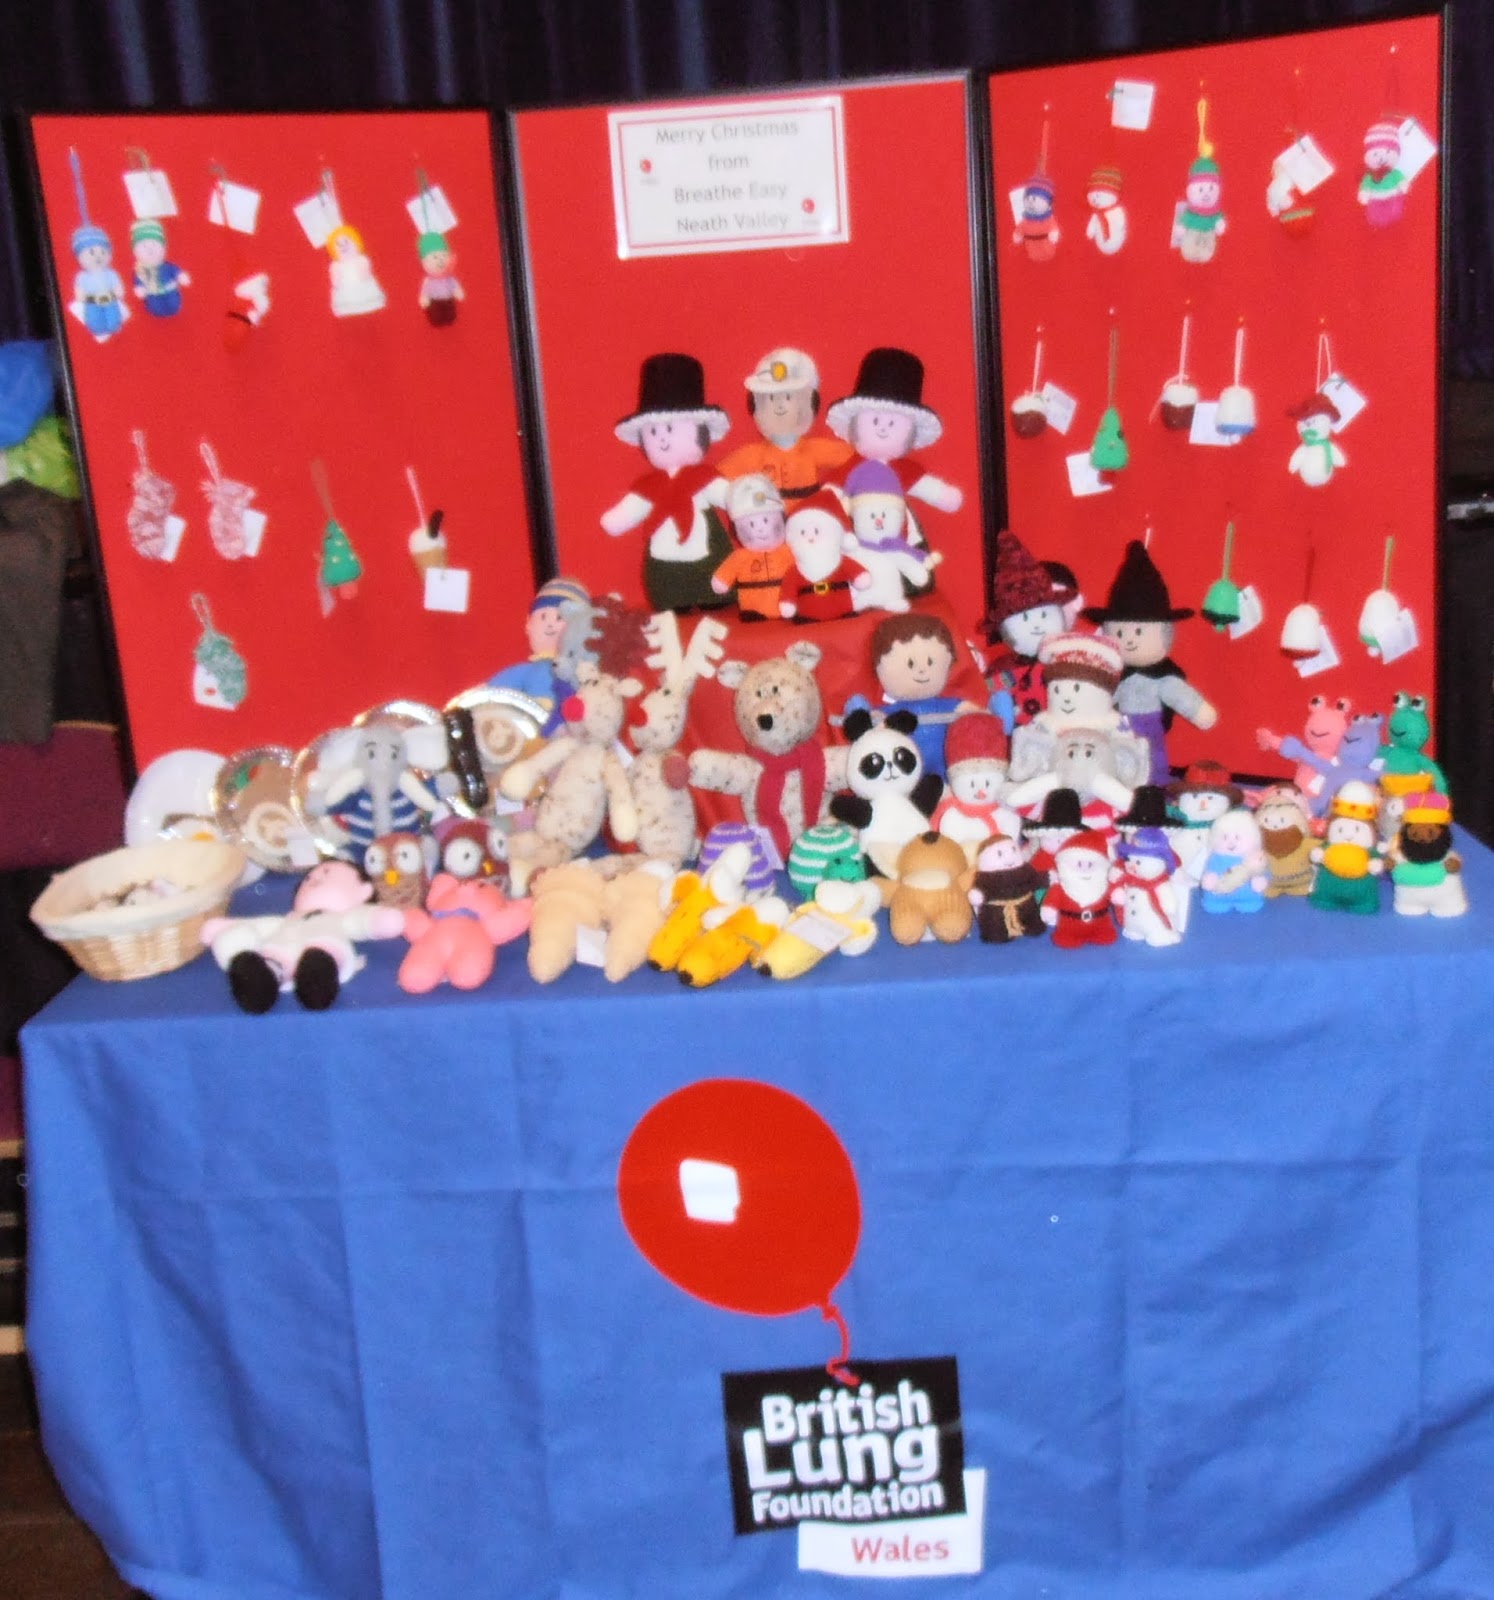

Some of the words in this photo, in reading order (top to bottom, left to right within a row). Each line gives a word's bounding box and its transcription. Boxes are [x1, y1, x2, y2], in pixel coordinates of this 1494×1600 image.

[655, 126, 705, 145] Merry
[711, 120, 798, 138] Christmas
[708, 153, 749, 172] from
[674, 184, 743, 204] Breathe
[749, 182, 788, 201] Easy
[677, 214, 728, 234] Neath
[735, 211, 788, 231] Valley
[762, 1378, 931, 1443] British
[743, 1425, 940, 1490] Lung
[752, 1480, 945, 1524] Foundation
[851, 1534, 950, 1564] Wales
